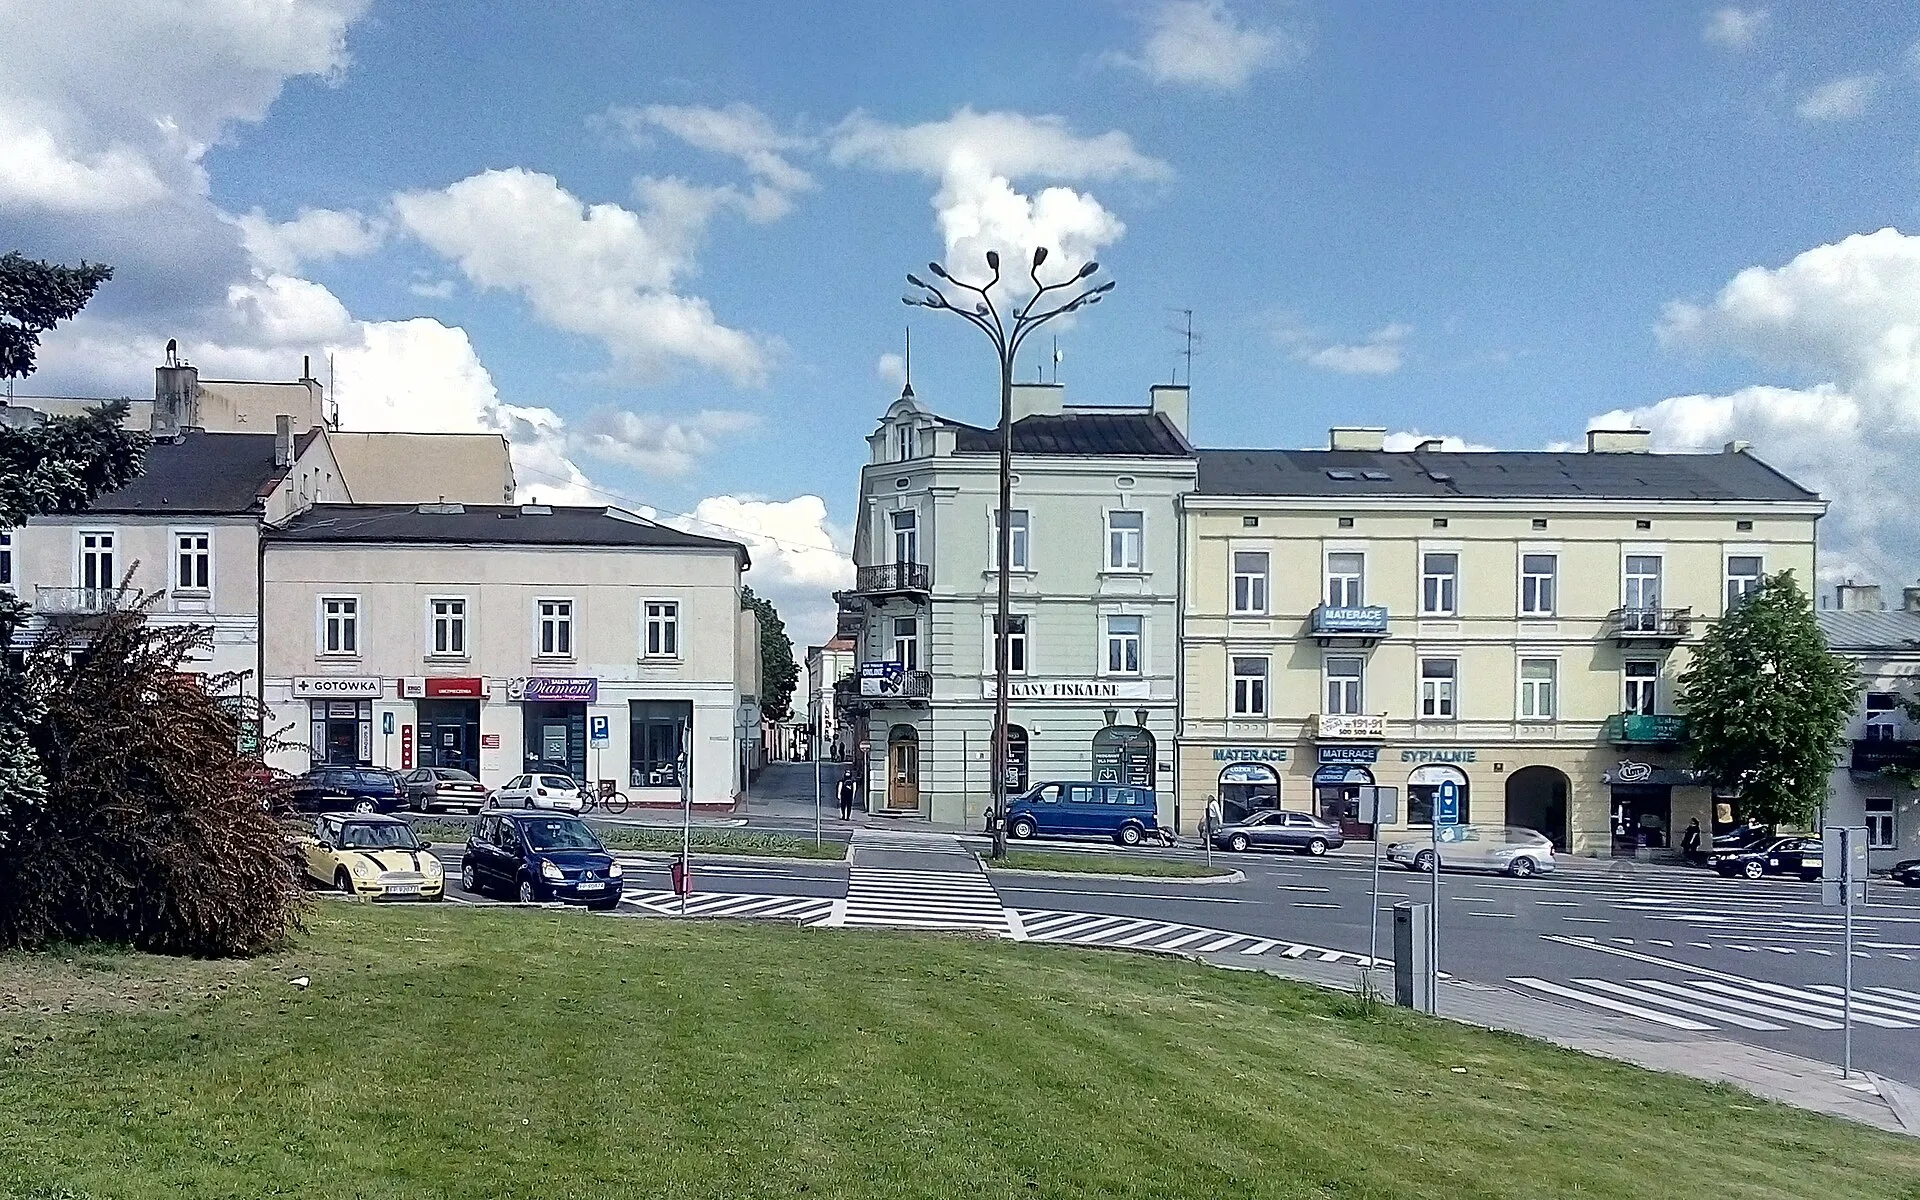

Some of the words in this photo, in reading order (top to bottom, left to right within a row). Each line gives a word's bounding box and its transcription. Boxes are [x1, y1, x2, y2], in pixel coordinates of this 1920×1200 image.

[1325, 610, 1382, 619] MATERACE
[314, 680, 377, 691] GOTÓWKA
[524, 678, 593, 694] Diament
[1011, 682, 1048, 696] KASY
[1052, 682, 1120, 696] FISKALNE
[594, 718, 605, 733] P
[1213, 749, 1287, 761] MATERACE
[1323, 749, 1375, 758] MATERACE
[1401, 750, 1477, 762] SYPIALNIE
